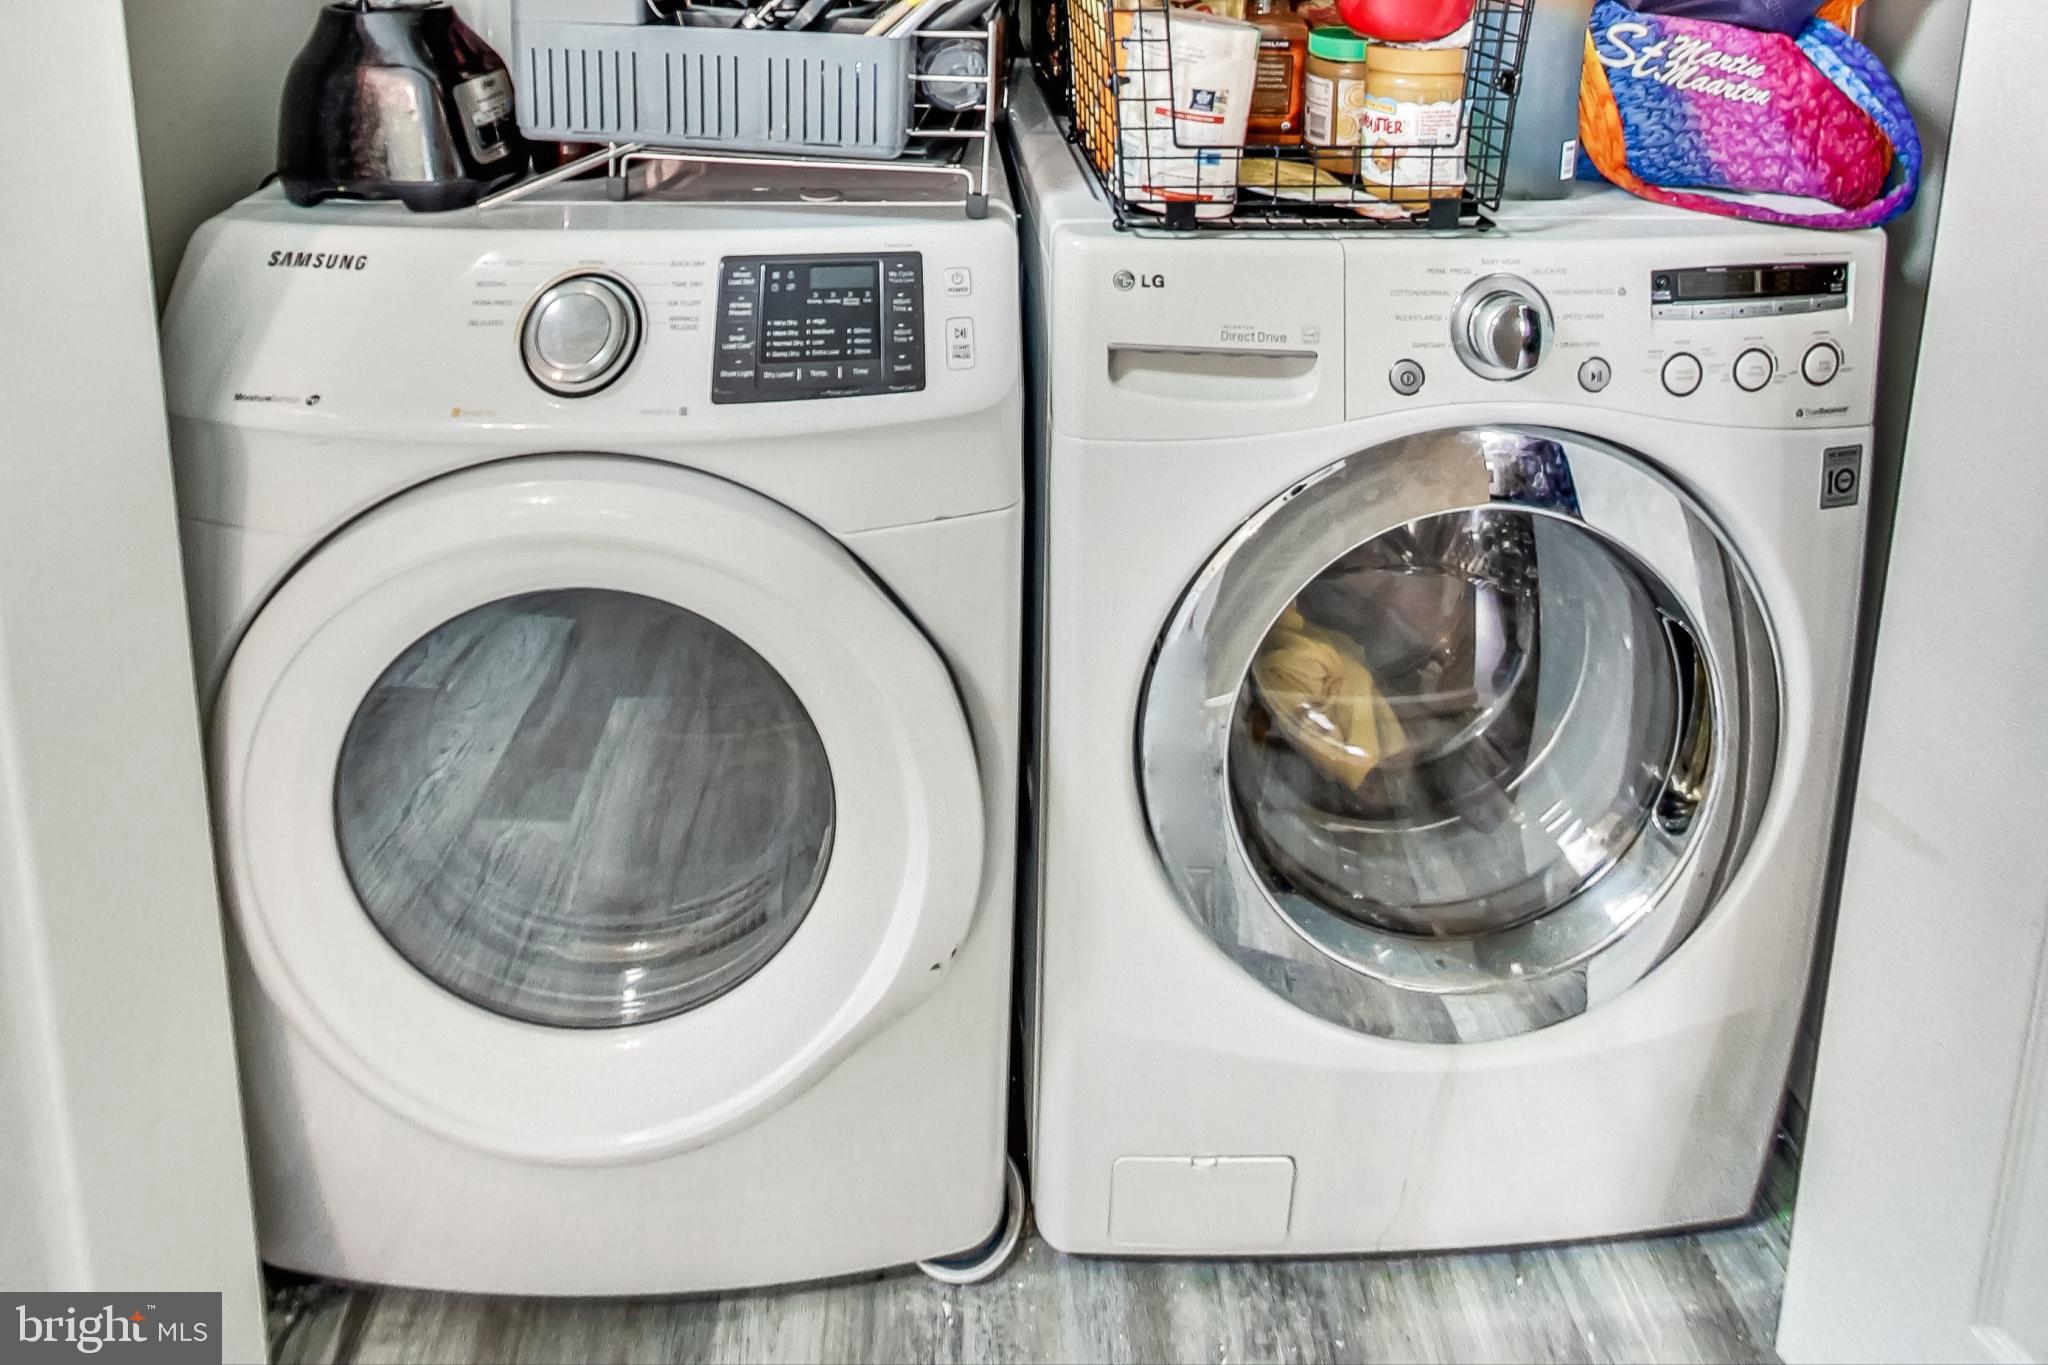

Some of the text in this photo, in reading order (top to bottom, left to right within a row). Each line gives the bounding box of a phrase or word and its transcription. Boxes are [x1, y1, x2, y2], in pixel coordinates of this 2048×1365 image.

[1667, 34, 1767, 79] Martin
[1660, 61, 1771, 106] Maarten
[267, 250, 369, 271] SAMSUNG
[1141, 274, 1165, 288] LG
[1220, 330, 1287, 344] Direct Drive
